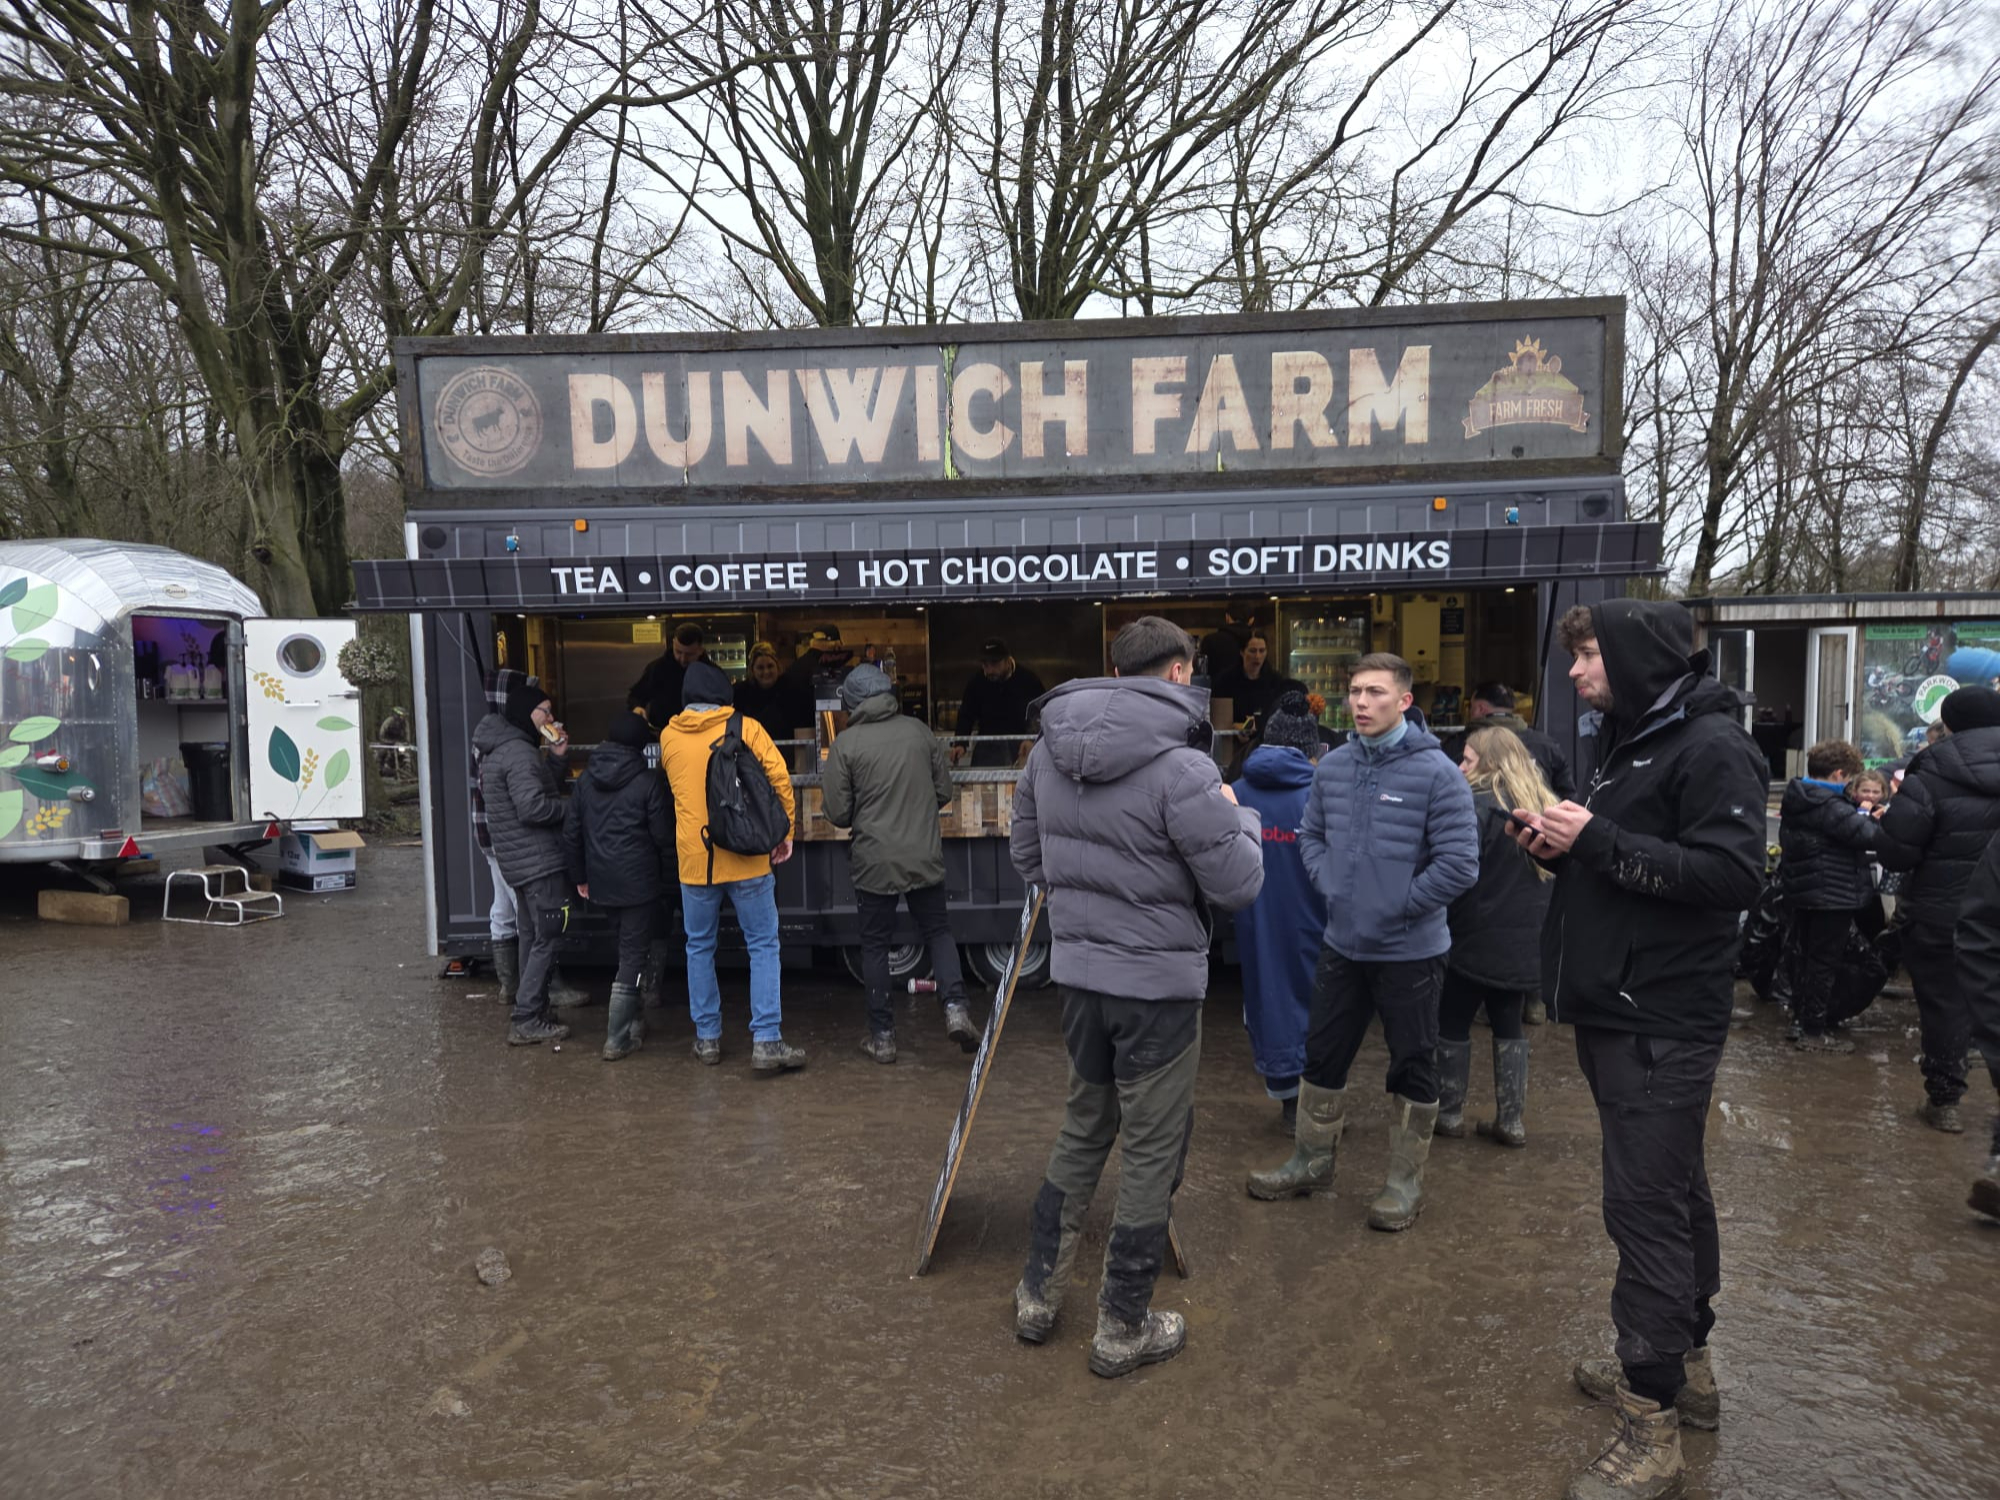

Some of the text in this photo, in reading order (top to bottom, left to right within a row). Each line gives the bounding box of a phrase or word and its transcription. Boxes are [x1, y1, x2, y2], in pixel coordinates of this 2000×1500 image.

[444, 375, 487, 424] DUNWICH
[568, 345, 1432, 469] DUNWICH FARM
[1488, 399, 1564, 422] FARM FRESH
[550, 540, 1450, 596] TEA COFFEE HOT CHOCOLATE SOFT DRINKS
[1919, 677, 1959, 697] PARKWOO
